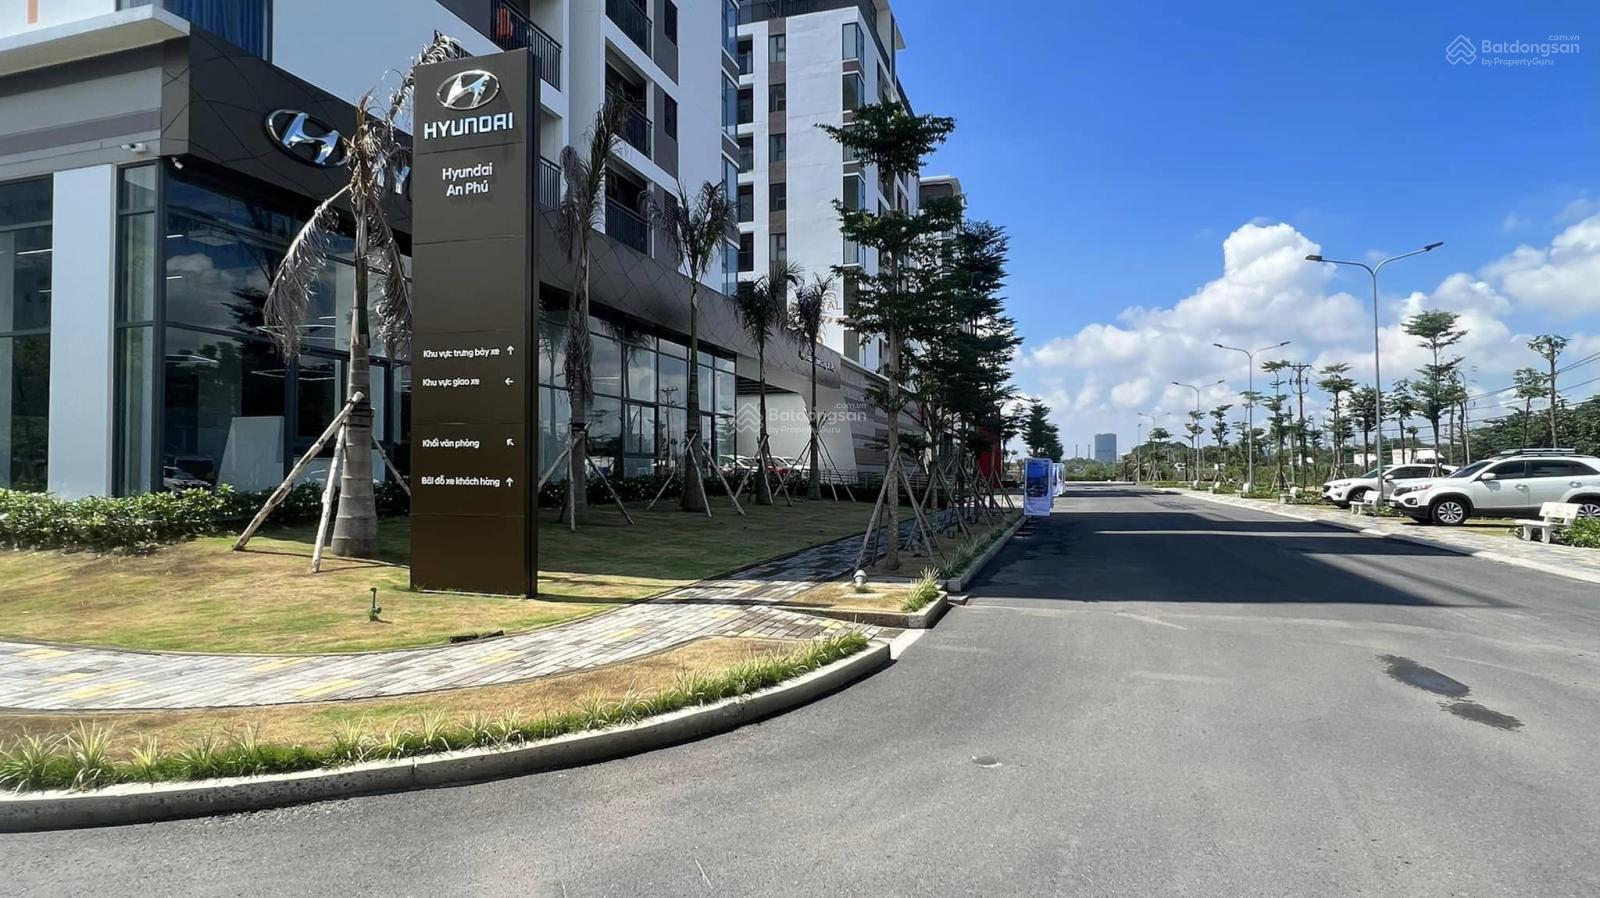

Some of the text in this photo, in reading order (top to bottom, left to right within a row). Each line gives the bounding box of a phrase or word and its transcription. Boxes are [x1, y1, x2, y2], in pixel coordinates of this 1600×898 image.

[424, 112, 514, 140] HYUNDAI
[442, 162, 493, 181] Hyundai
[446, 180, 489, 197] An Phú
[423, 349, 438, 358] Khu
[438, 350, 453, 359] vực
[453, 349, 474, 359] trưng
[490, 348, 500, 356] xe
[422, 377, 480, 388] Khu vực giao xe
[445, 478, 455, 486] xe
[455, 476, 480, 486] khách
